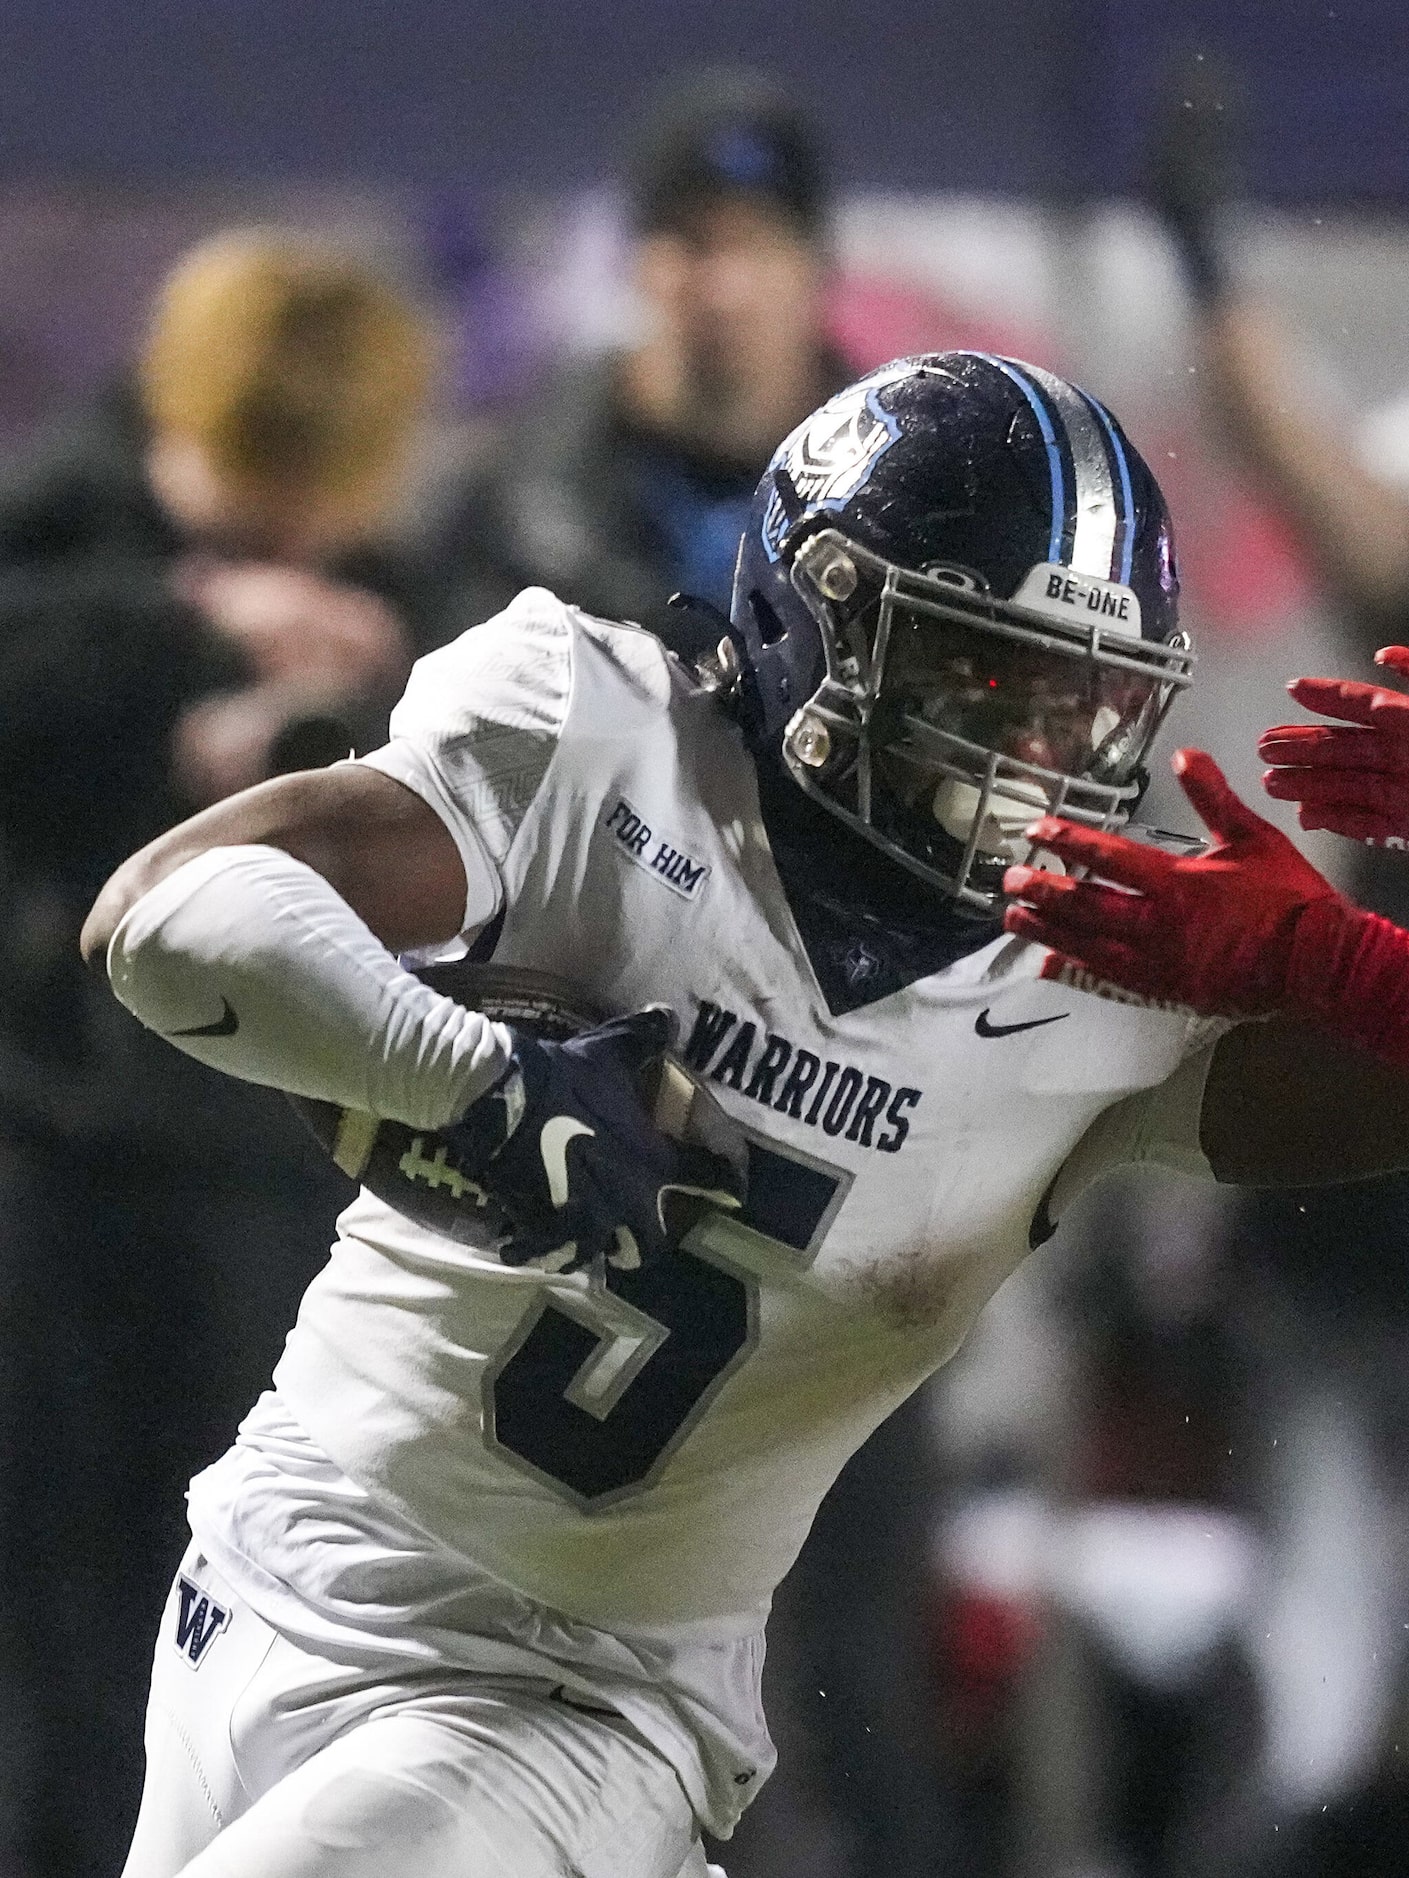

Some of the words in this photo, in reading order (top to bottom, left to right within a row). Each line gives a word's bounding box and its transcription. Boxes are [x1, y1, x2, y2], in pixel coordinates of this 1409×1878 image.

[1045, 573, 1131, 620] BE-ONE
[605, 801, 652, 856] FOR
[650, 842, 706, 893] HIM
[684, 999, 923, 1154] WARRIORS
[481, 1136, 856, 1518] 5
[176, 1574, 230, 1664] W
